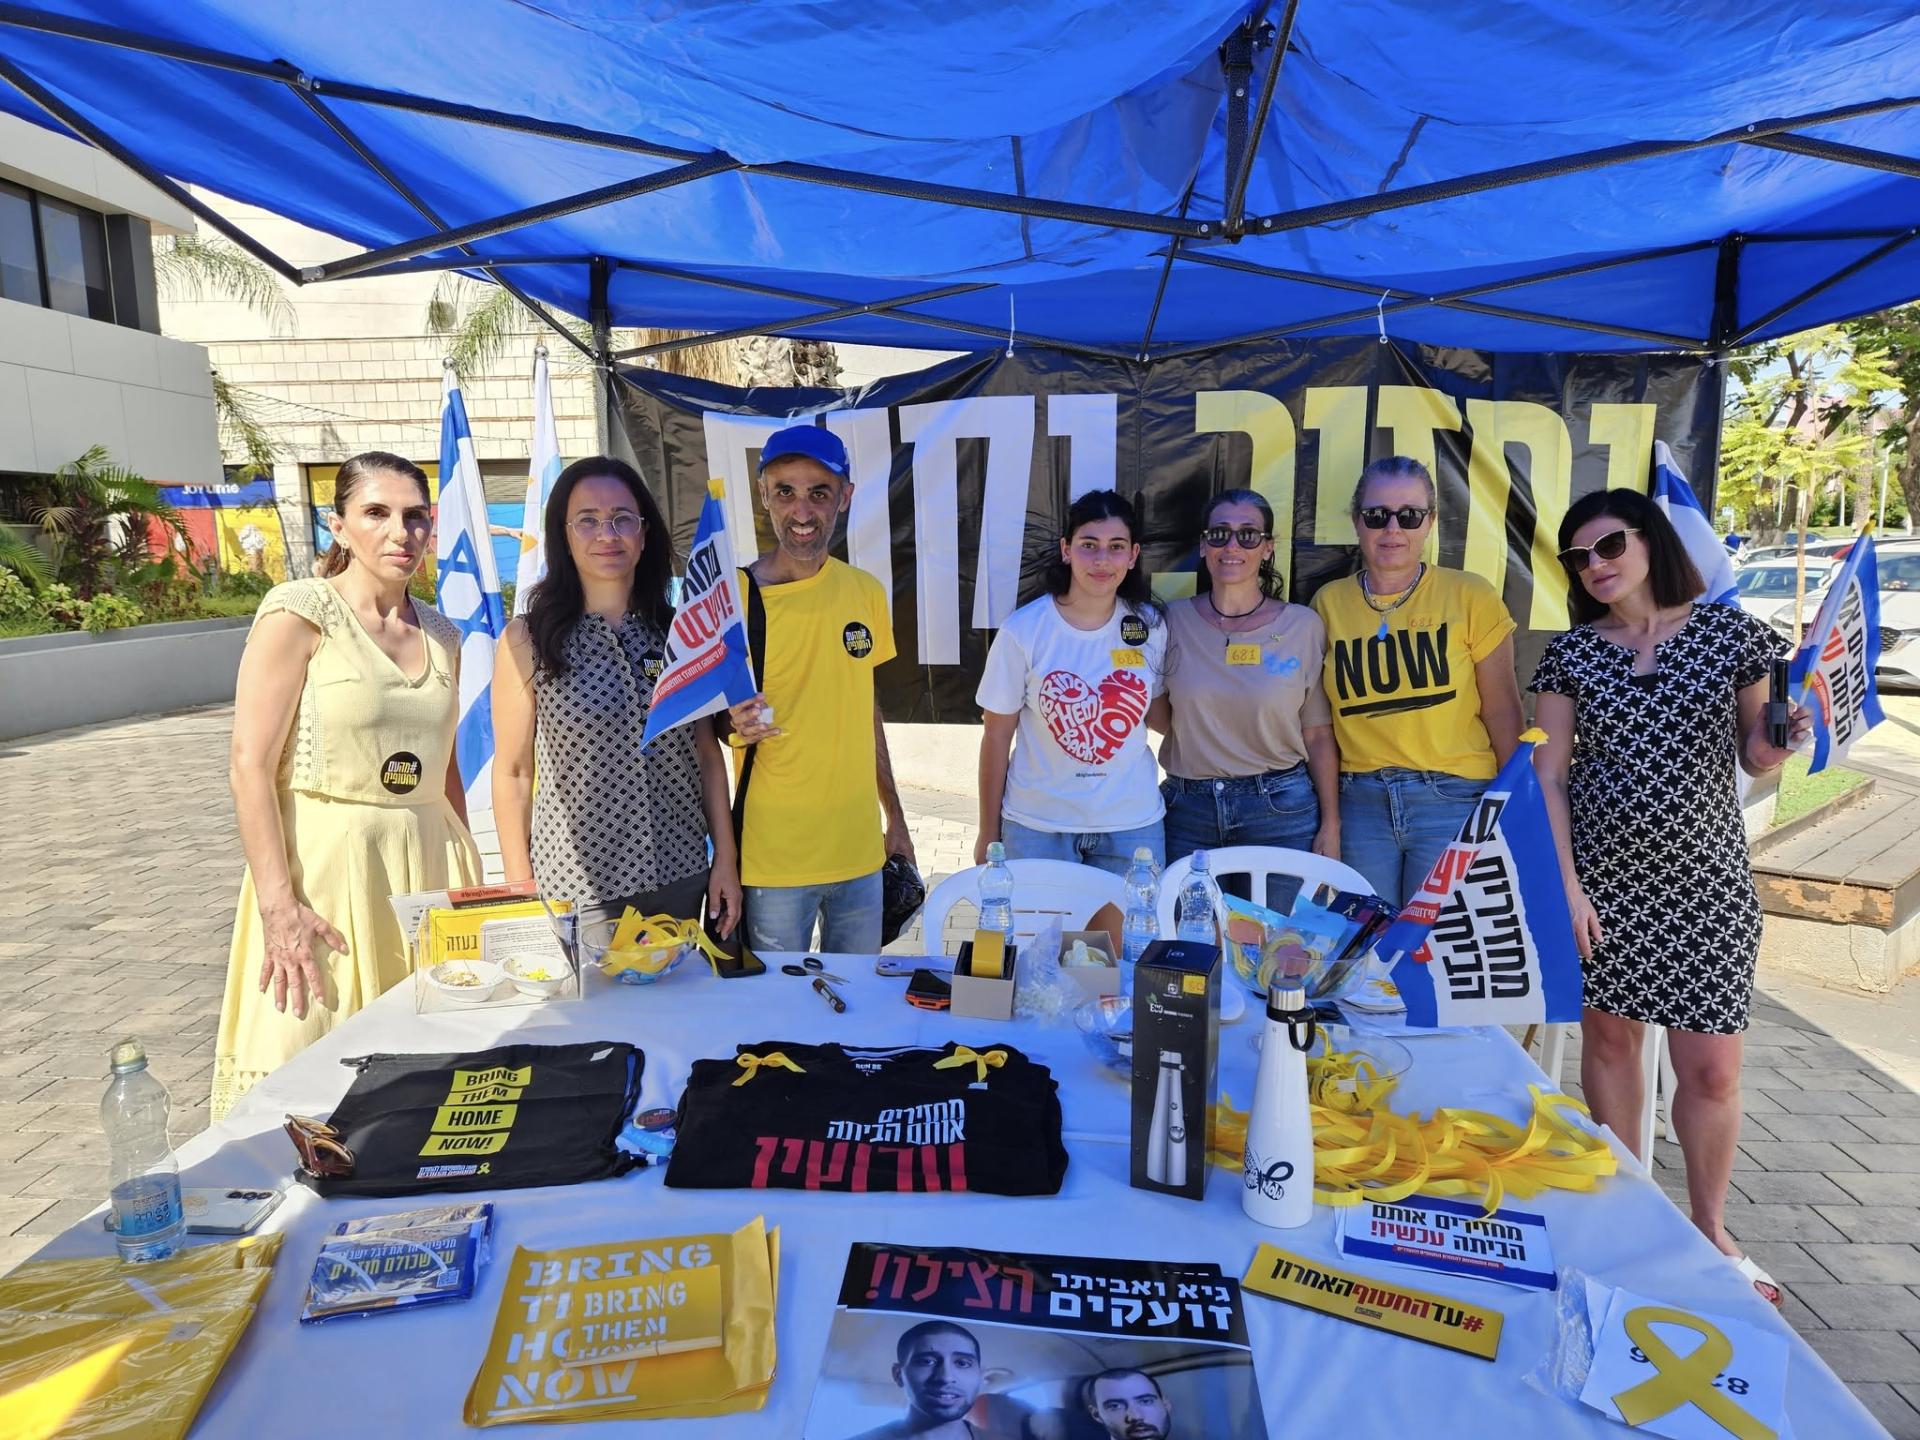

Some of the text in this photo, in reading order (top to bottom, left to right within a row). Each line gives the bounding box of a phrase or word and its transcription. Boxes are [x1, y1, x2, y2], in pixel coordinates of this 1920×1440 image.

[1410, 617, 1434, 628] 681
[1232, 648, 1256, 661] 681
[1335, 622, 1450, 700] NOW
[1829, 662, 1853, 746] הביתה
[383, 772, 418, 786] החטופים
[1465, 855, 1530, 998] מחזירים
[446, 934, 478, 952] בעזה
[466, 1070, 518, 1087] BRING
[460, 1087, 508, 1103] THEM
[448, 1109, 503, 1127] HOME
[878, 1098, 966, 1124] מחזירים
[438, 1136, 494, 1151] NOW!
[827, 1117, 967, 1145] אותם הביתה
[1370, 1220, 1446, 1247] עכשיו!
[1372, 1204, 1524, 1242] מחזירים אותם
[1453, 1234, 1527, 1262] הביתה
[384, 1253, 431, 1273] שכולם
[524, 1243, 713, 1288] BRING
[864, 1252, 1035, 1314] הצילו!
[1050, 1272, 1230, 1302] גיא ואביתר
[1270, 1257, 1485, 1333] #עדהחטוףהאחרון
[584, 1281, 687, 1317] BRING
[1048, 1290, 1234, 1331] זועקים
[582, 1316, 668, 1344] THEM
[494, 1361, 639, 1408] NOW
